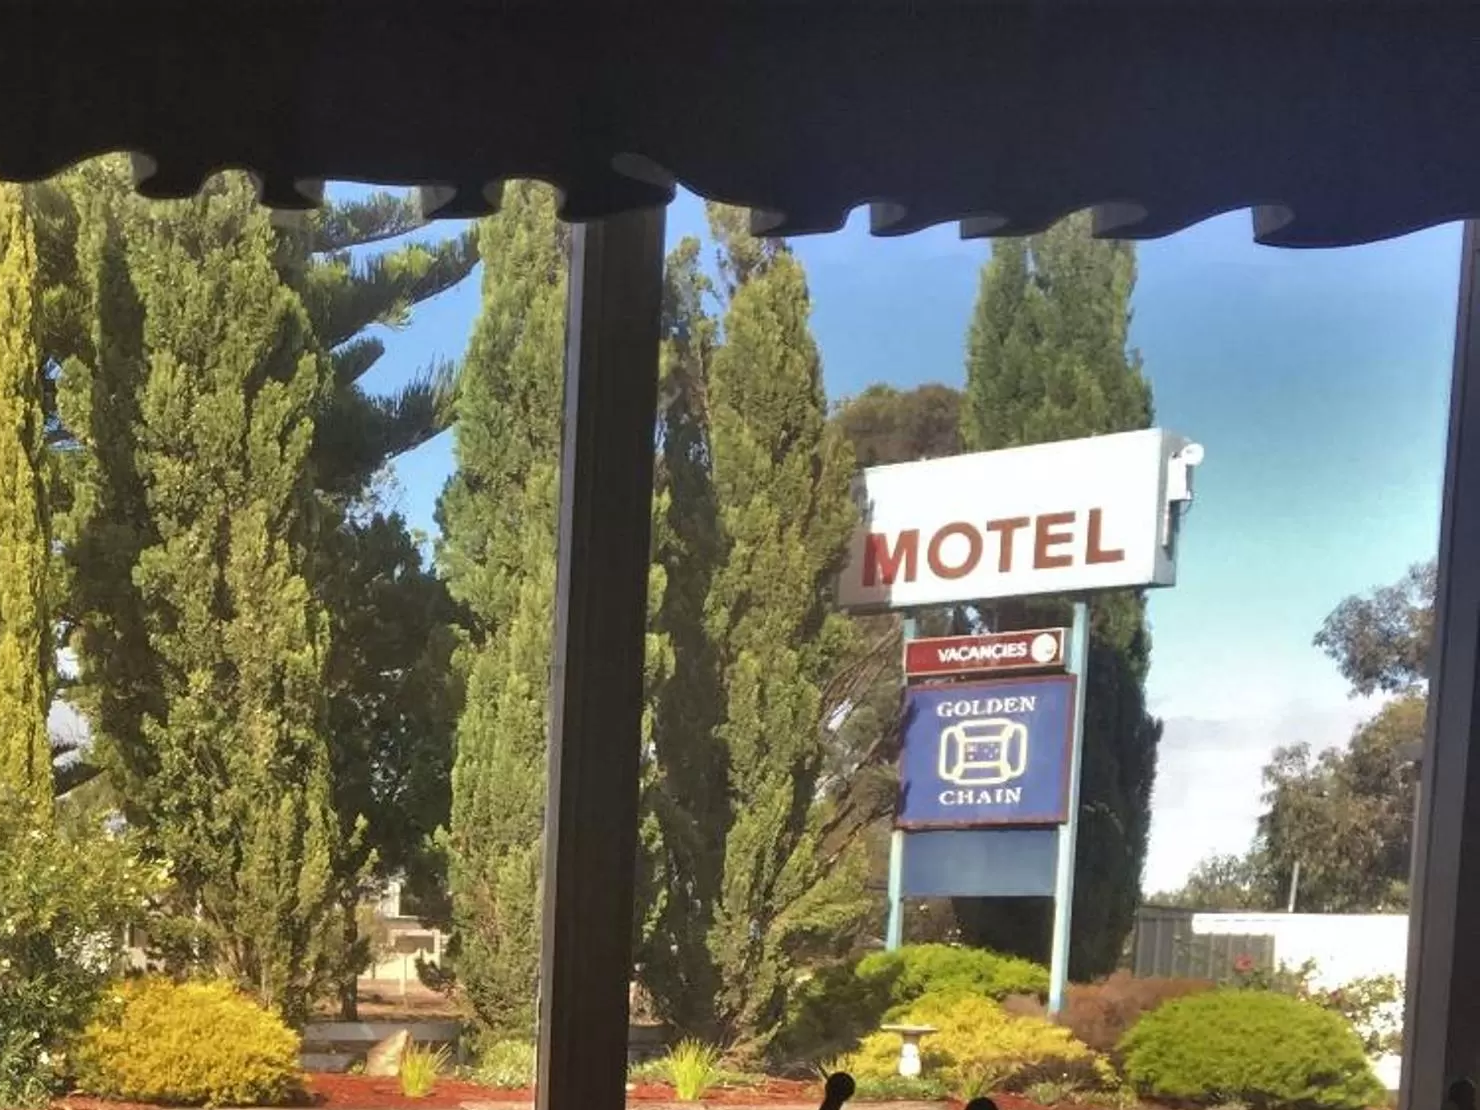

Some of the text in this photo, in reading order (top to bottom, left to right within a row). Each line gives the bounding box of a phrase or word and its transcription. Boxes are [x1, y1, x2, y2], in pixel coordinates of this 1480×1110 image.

[862, 508, 1125, 587] MOTEL
[937, 642, 1028, 663] VACANCIES
[936, 696, 1037, 718] GOLDEN
[938, 787, 1024, 806] CHAIN
